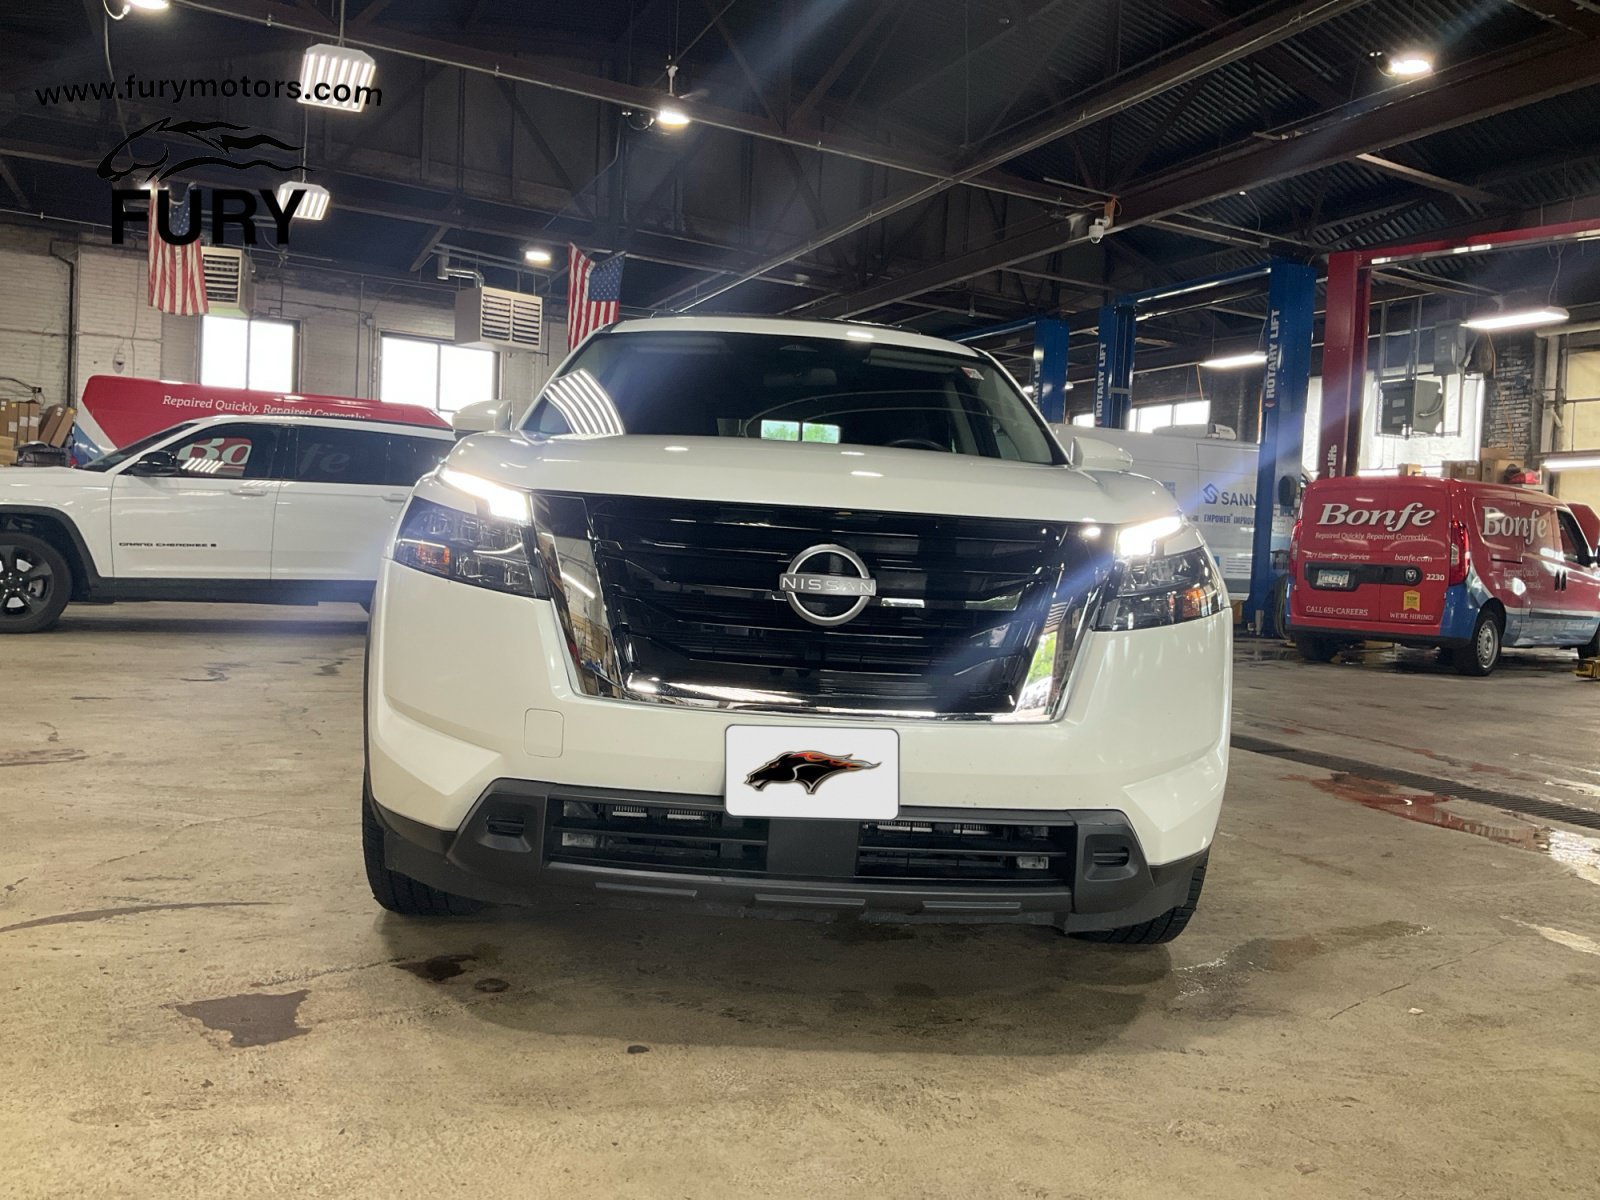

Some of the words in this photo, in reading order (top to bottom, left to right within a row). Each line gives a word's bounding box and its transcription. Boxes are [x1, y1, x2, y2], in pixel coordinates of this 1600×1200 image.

[1270, 309, 1280, 339] LIFT
[1099, 342, 1107, 367] LIFT
[1266, 343, 1278, 399] ROTARY
[163, 395, 218, 409] Repaired
[215, 400, 259, 414] Quickly.
[1096, 372, 1105, 418] ROTARY
[1316, 502, 1436, 532] Bonfe
[1482, 506, 1548, 545] Bonfe
[1366, 533, 1394, 541] Repaired
[782, 577, 874, 594] NISSAN
[1426, 573, 1445, 581] 2230
[1306, 605, 1323, 614] CALL
